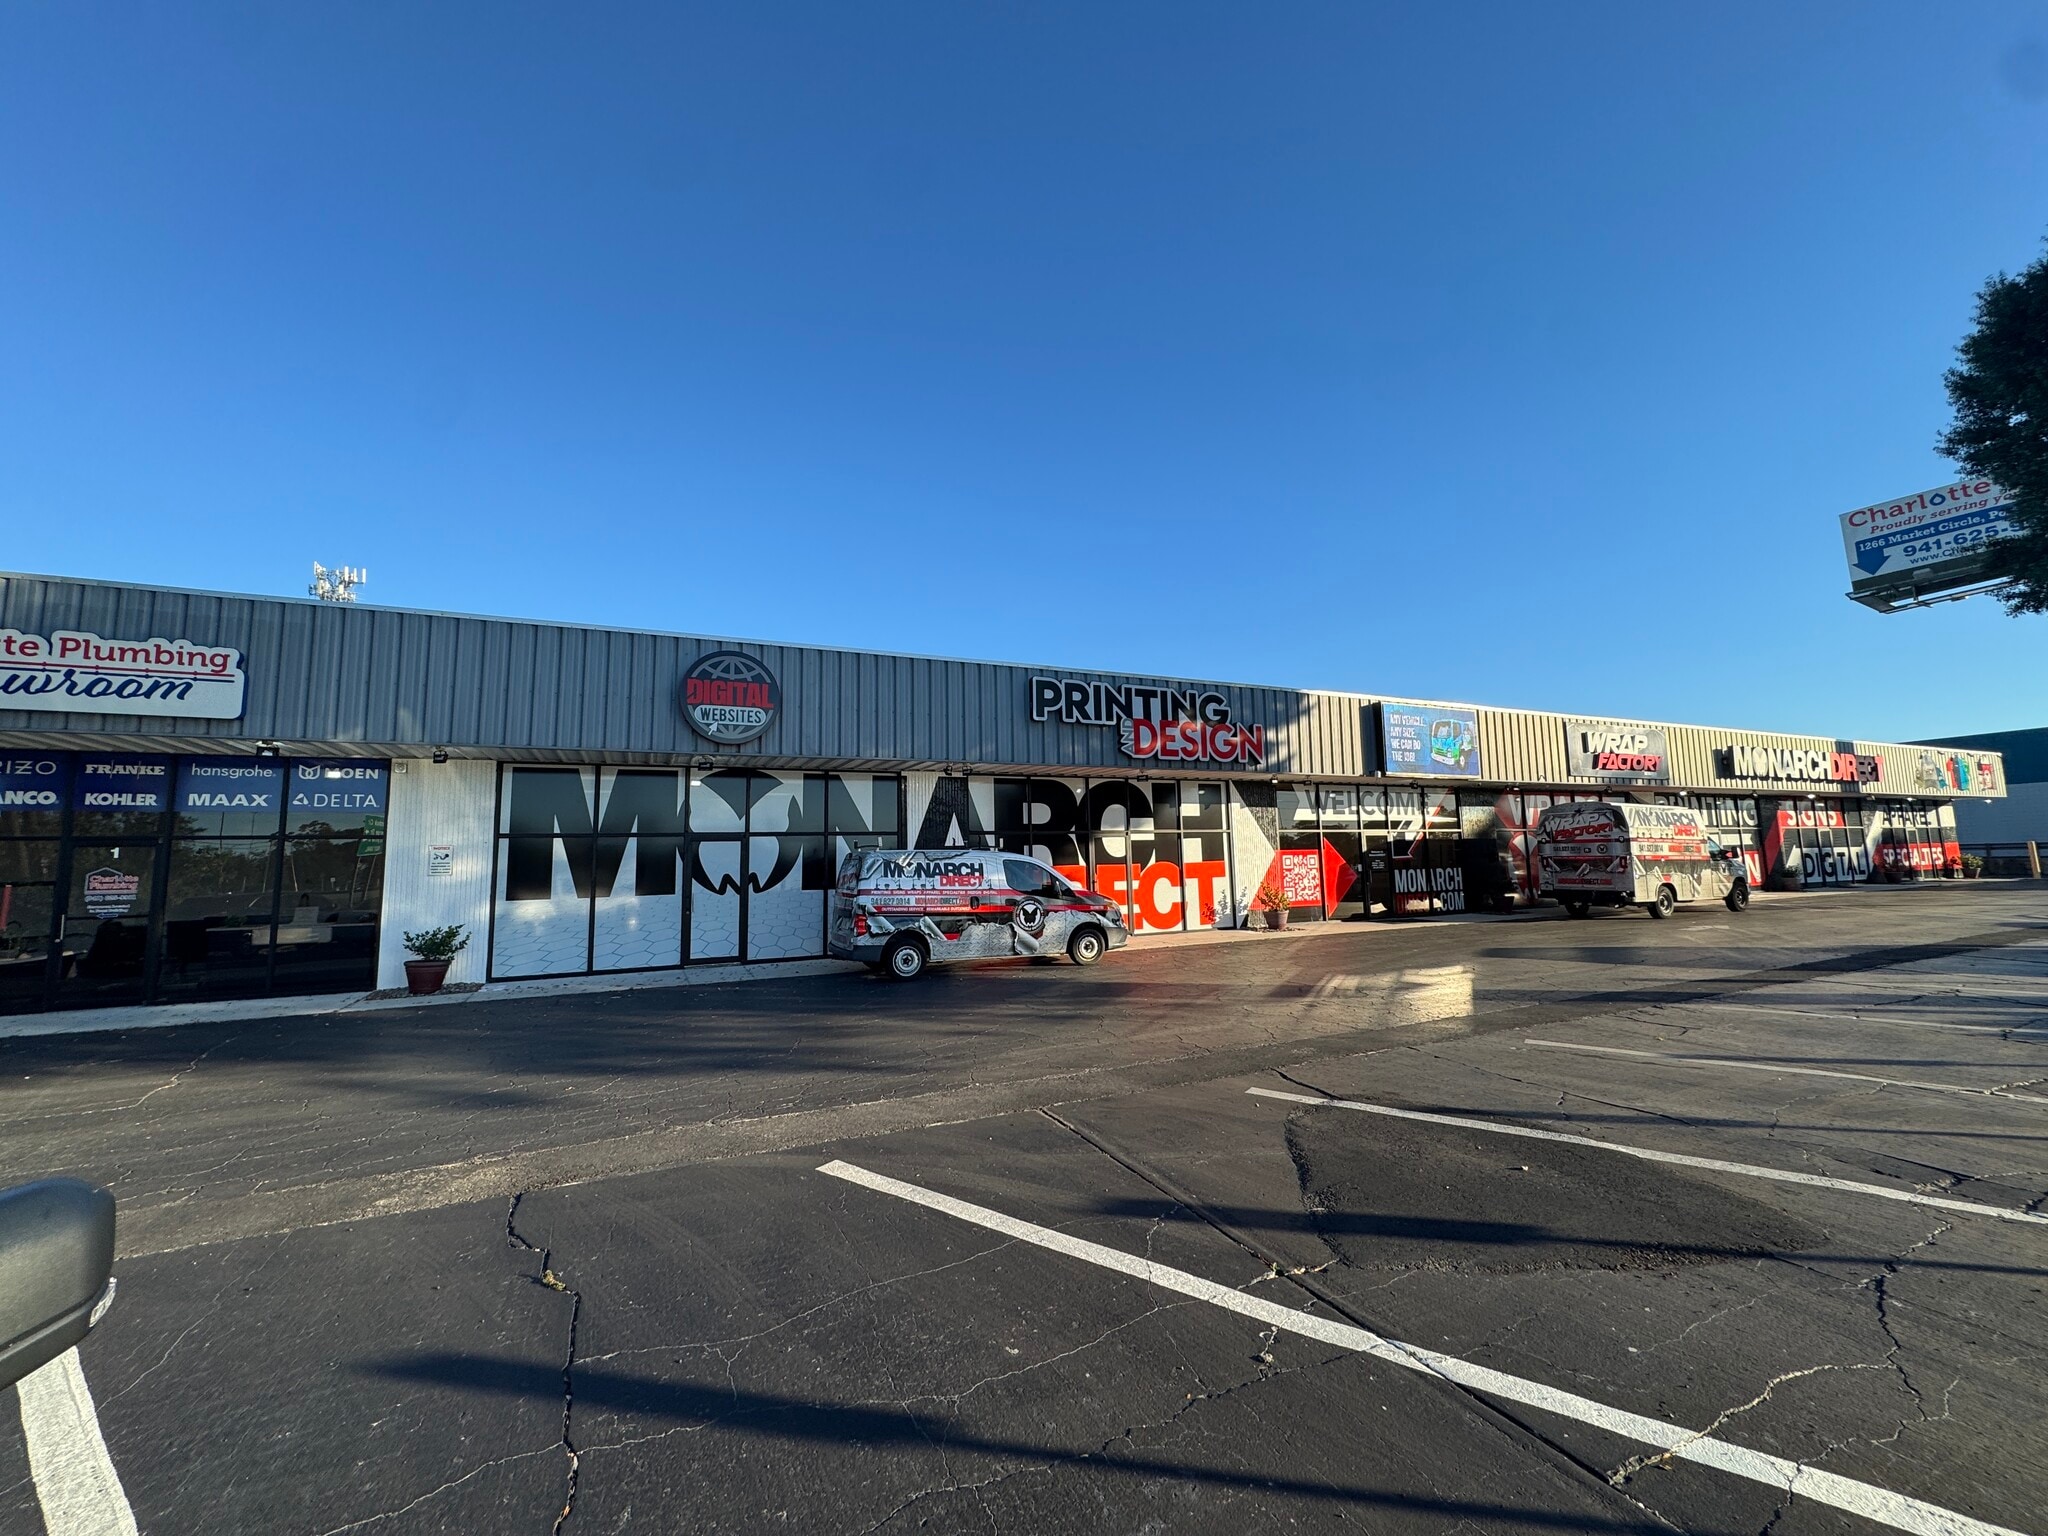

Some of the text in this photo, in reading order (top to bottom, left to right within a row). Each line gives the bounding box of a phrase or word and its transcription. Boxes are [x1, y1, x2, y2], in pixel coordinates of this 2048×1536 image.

[1848, 481, 1991, 527] Charlotte
[1870, 491, 2017, 534] Proudly serving yo
[1859, 510, 2008, 551] 1266 Market Circle, Po
[1903, 521, 2023, 557] 941-625-9
[0, 635, 231, 674] te Plumbing
[687, 678, 774, 708] DIGITAL
[1034, 678, 1230, 727] PRINTING
[700, 707, 762, 724] WEBSITES
[1121, 718, 1133, 753] AND
[1132, 717, 1265, 763] DESIGN
[1391, 738, 1401, 749] WE
[1401, 739, 1413, 750] CAN
[1586, 731, 1648, 755] WRAP
[1391, 750, 1403, 761] THE
[1597, 752, 1664, 771] FACTORY
[0, 760, 57, 775] IZO
[84, 763, 165, 777] FRANKE
[191, 763, 273, 779] hansgrohe
[84, 792, 158, 806] KOHLER
[187, 793, 269, 807] MAAX
[314, 793, 377, 808] DELTA
[1544, 813, 1600, 832] WRAP
[1636, 809, 1698, 827] MONARCH
[110, 847, 119, 859] 1
[883, 859, 984, 878] MONARCH
[1803, 852, 1866, 878] DIGTAL
[939, 875, 985, 887] DIRECT
